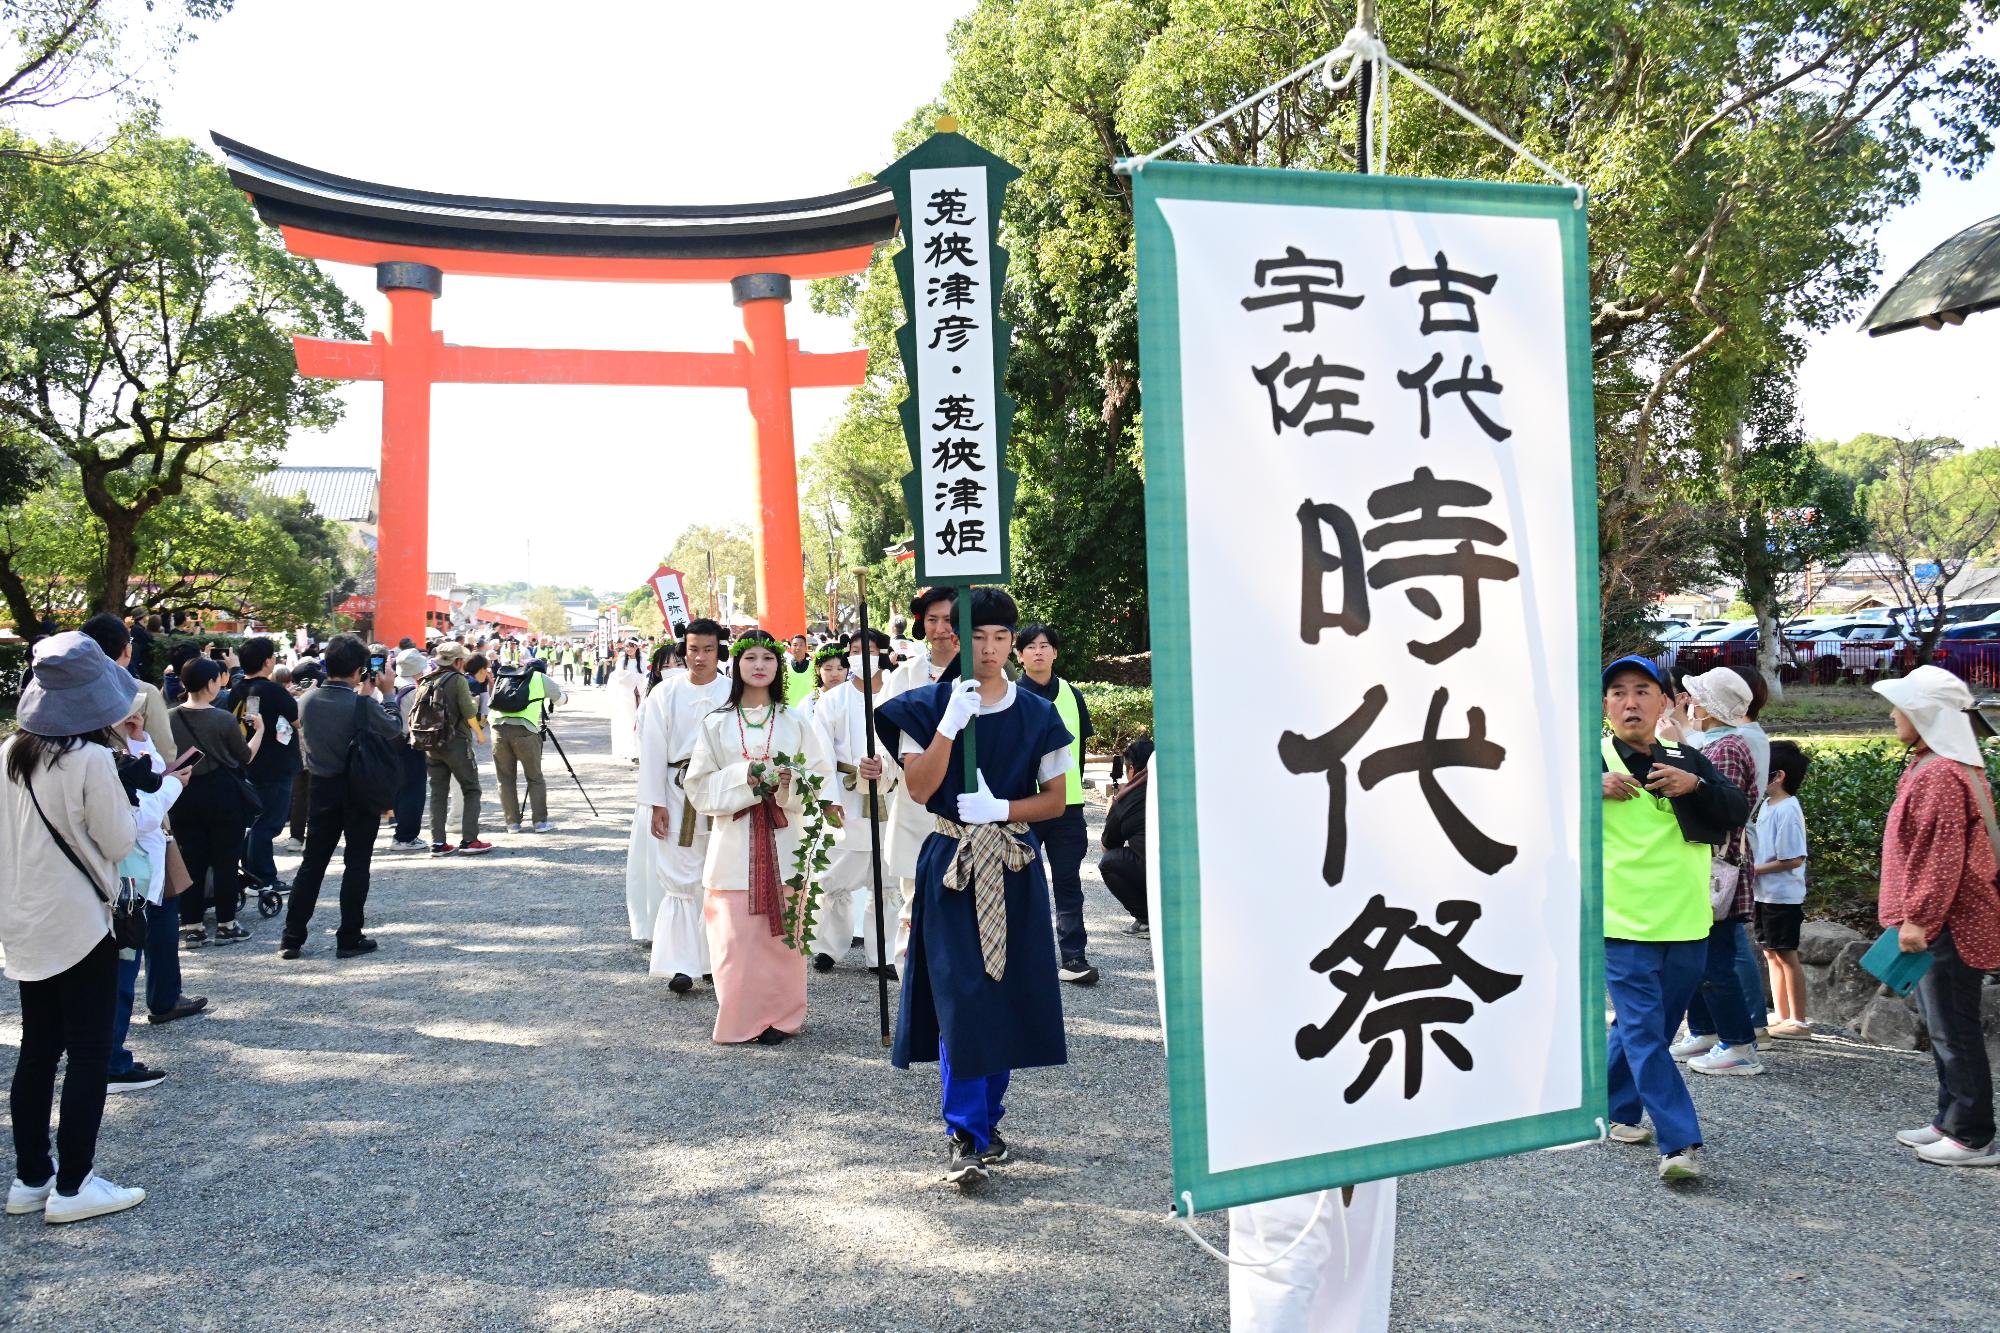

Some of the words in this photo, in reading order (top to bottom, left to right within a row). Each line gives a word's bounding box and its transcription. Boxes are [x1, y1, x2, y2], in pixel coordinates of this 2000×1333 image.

[1241, 247, 1375, 437] 宇佐
[1389, 250, 1512, 443] 古代
[1277, 466, 1524, 1105] 時代祭
